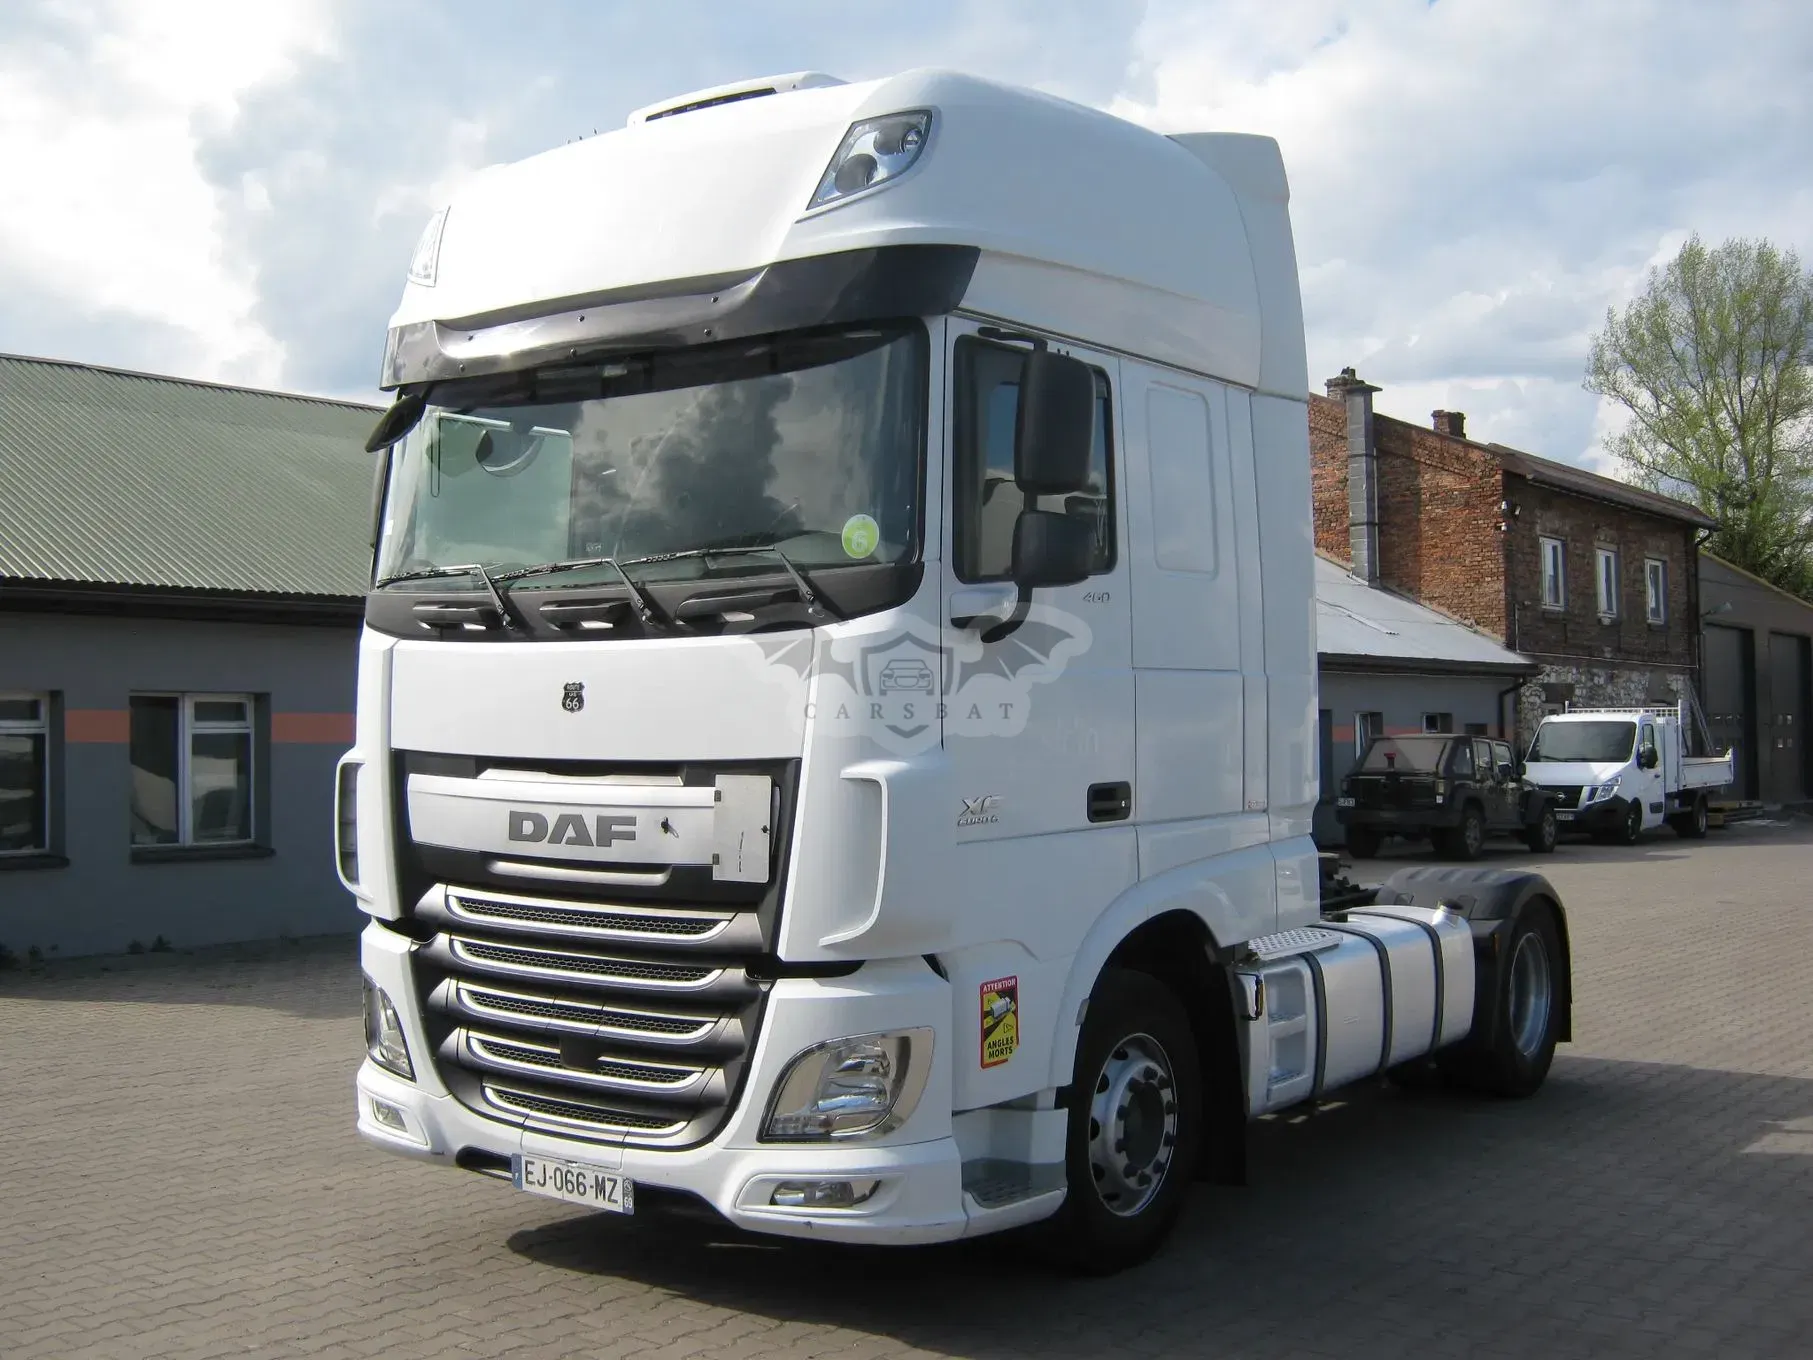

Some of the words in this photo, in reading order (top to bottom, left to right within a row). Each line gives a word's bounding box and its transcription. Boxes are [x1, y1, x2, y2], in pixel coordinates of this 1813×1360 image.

[565, 697, 580, 710] 66
[508, 810, 637, 848] DAF
[983, 978, 1017, 993] ATTENTION
[987, 1036, 1014, 1050] ANGLES
[988, 1046, 1013, 1059] MORTS
[524, 1159, 619, 1204] EJ-066-MZ
[624, 1196, 633, 1209] 69
